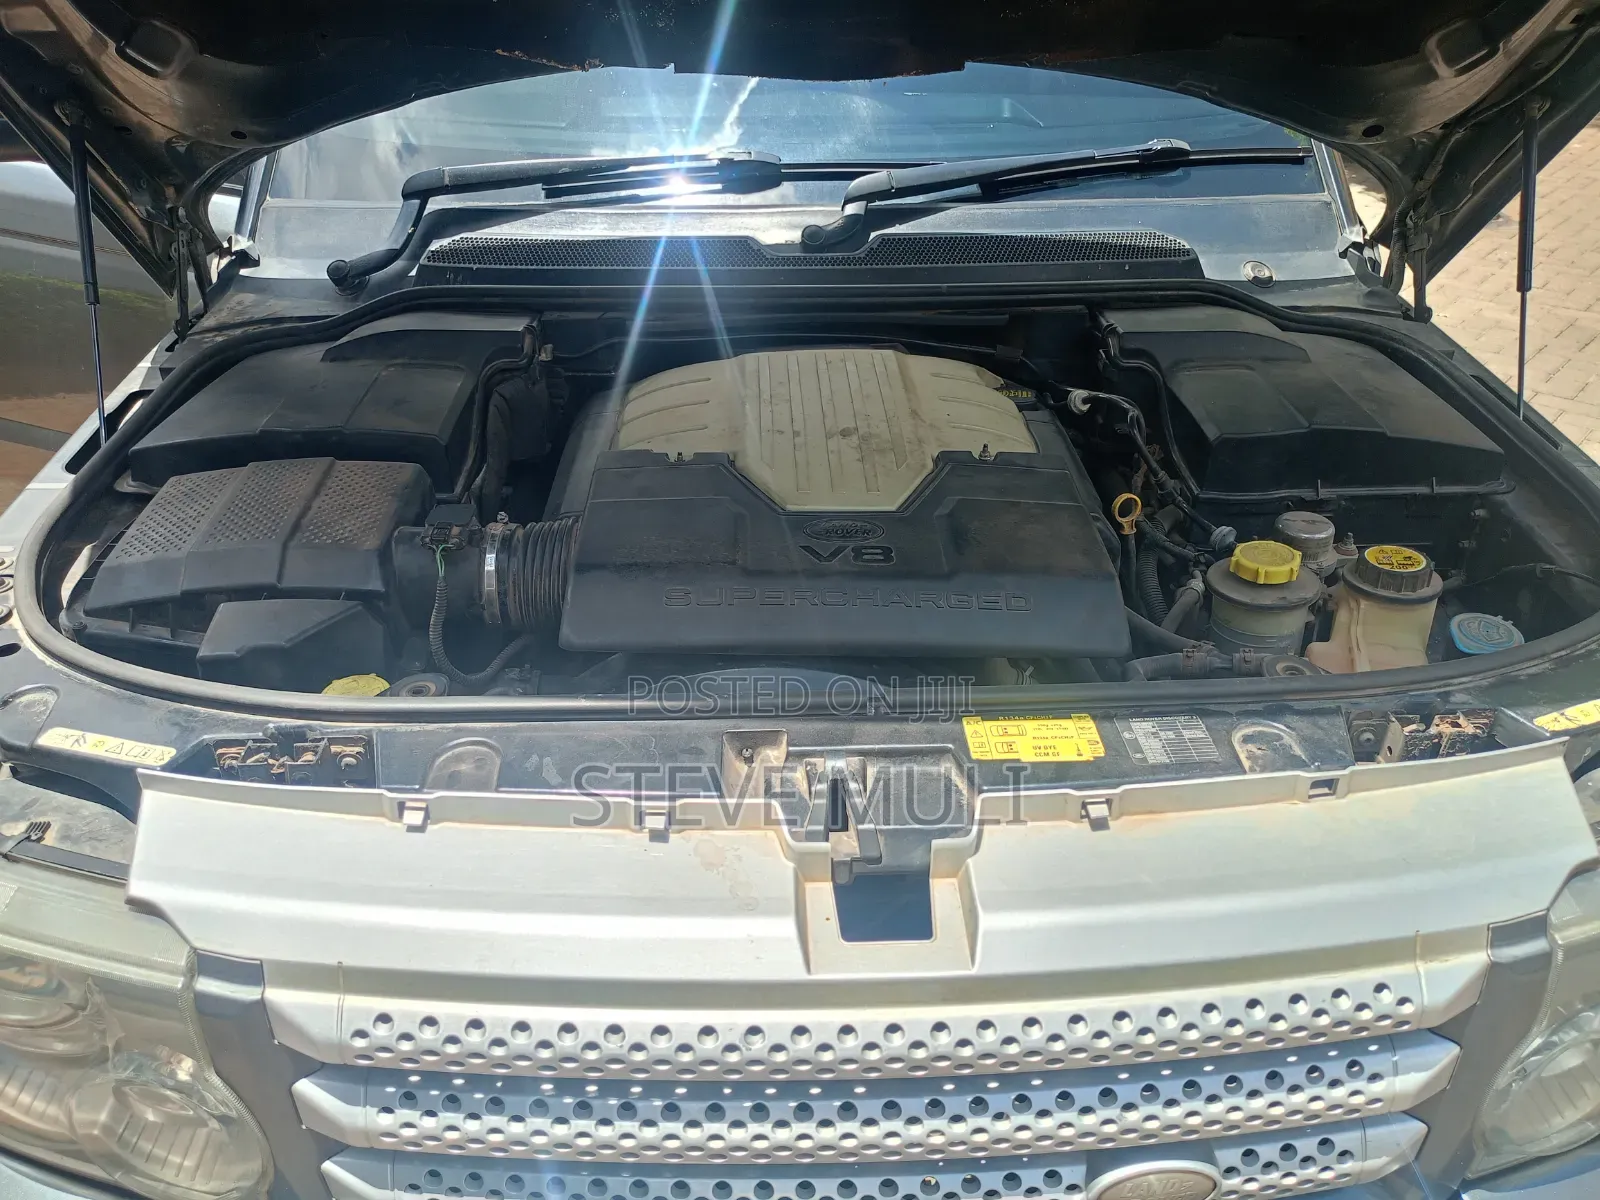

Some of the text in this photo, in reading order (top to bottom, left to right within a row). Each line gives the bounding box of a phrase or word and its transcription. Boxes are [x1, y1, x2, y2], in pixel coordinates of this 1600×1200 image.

[825, 528, 872, 537] ROVER
[799, 545, 896, 566] V8
[663, 586, 1034, 612] SUPERCHARGED
[1121, 1179, 1181, 1197] LAND
